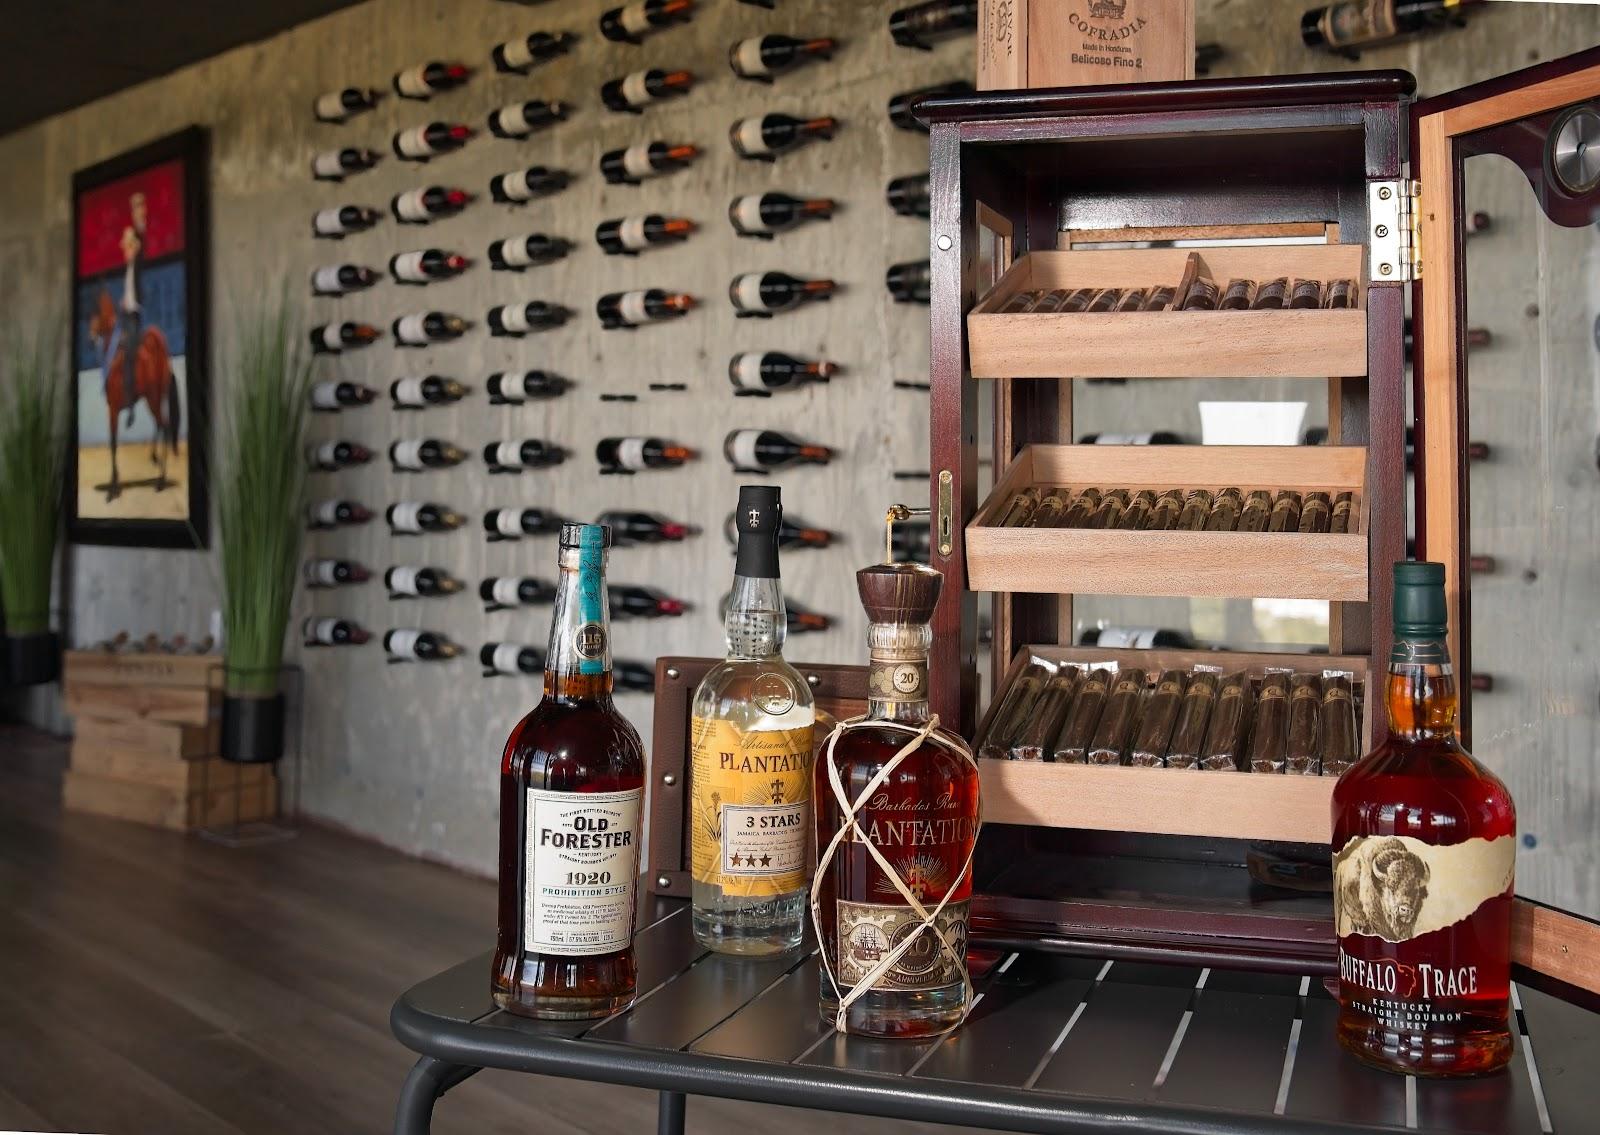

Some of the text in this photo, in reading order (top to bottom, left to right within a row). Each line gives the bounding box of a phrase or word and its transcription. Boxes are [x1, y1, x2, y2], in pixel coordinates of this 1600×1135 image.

[1068, 13, 1147, 41] COFRADIA
[1082, 43, 1097, 51] Made
[1105, 45, 1132, 53] Honduras
[1071, 53, 1143, 68] Belicoso Fino 2
[900, 672, 914, 684] 20
[733, 736, 791, 750] Artisanal
[719, 751, 811, 774] PLANTATIO
[868, 792, 961, 811] Barbados Rum
[573, 816, 609, 832] OLD
[746, 812, 801, 829] 3 STARS
[540, 828, 632, 850] FORESTER
[566, 871, 612, 886] 1920
[542, 885, 627, 896] PROHIBITION STYLE
[1339, 946, 1478, 999] BUFFALO TRACE
[1352, 1001, 1462, 1022] STRAIGHT BOURBON
[1372, 998, 1432, 1012] KENTUCKY
[1377, 1017, 1428, 1031] WHISKEY
